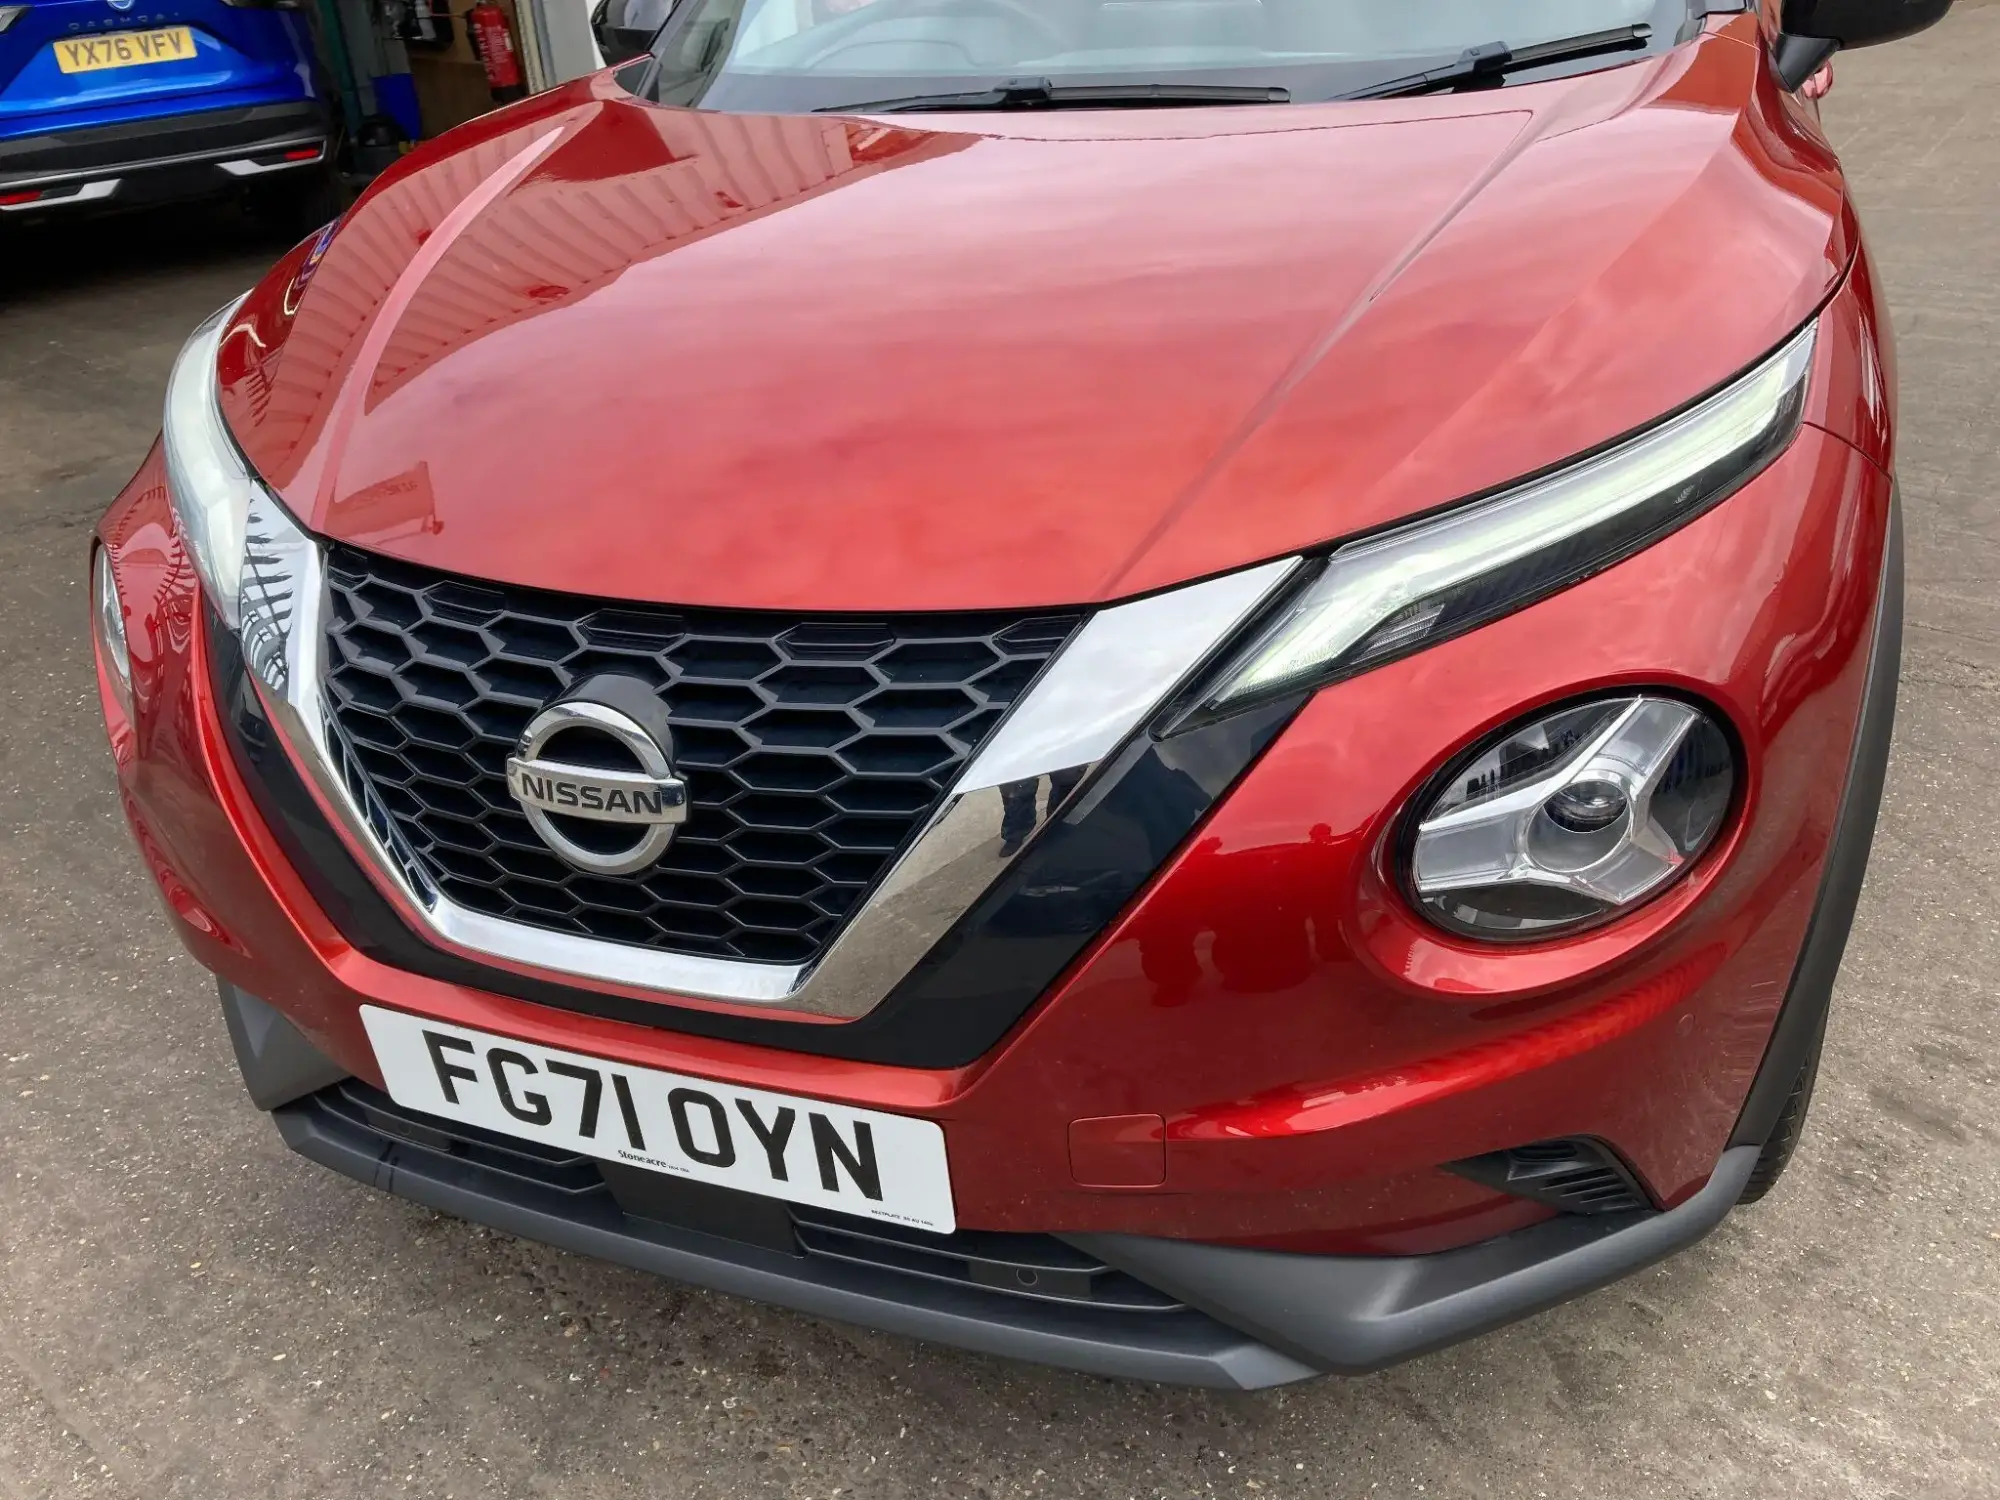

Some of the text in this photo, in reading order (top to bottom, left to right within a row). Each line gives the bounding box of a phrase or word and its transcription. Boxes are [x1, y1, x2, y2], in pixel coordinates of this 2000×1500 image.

[65, 31, 181, 66] YX76 VFV
[521, 773, 663, 814] NISSAN
[422, 1029, 884, 1201] FG71 OYN
[618, 1150, 667, 1168] Stoneacre
